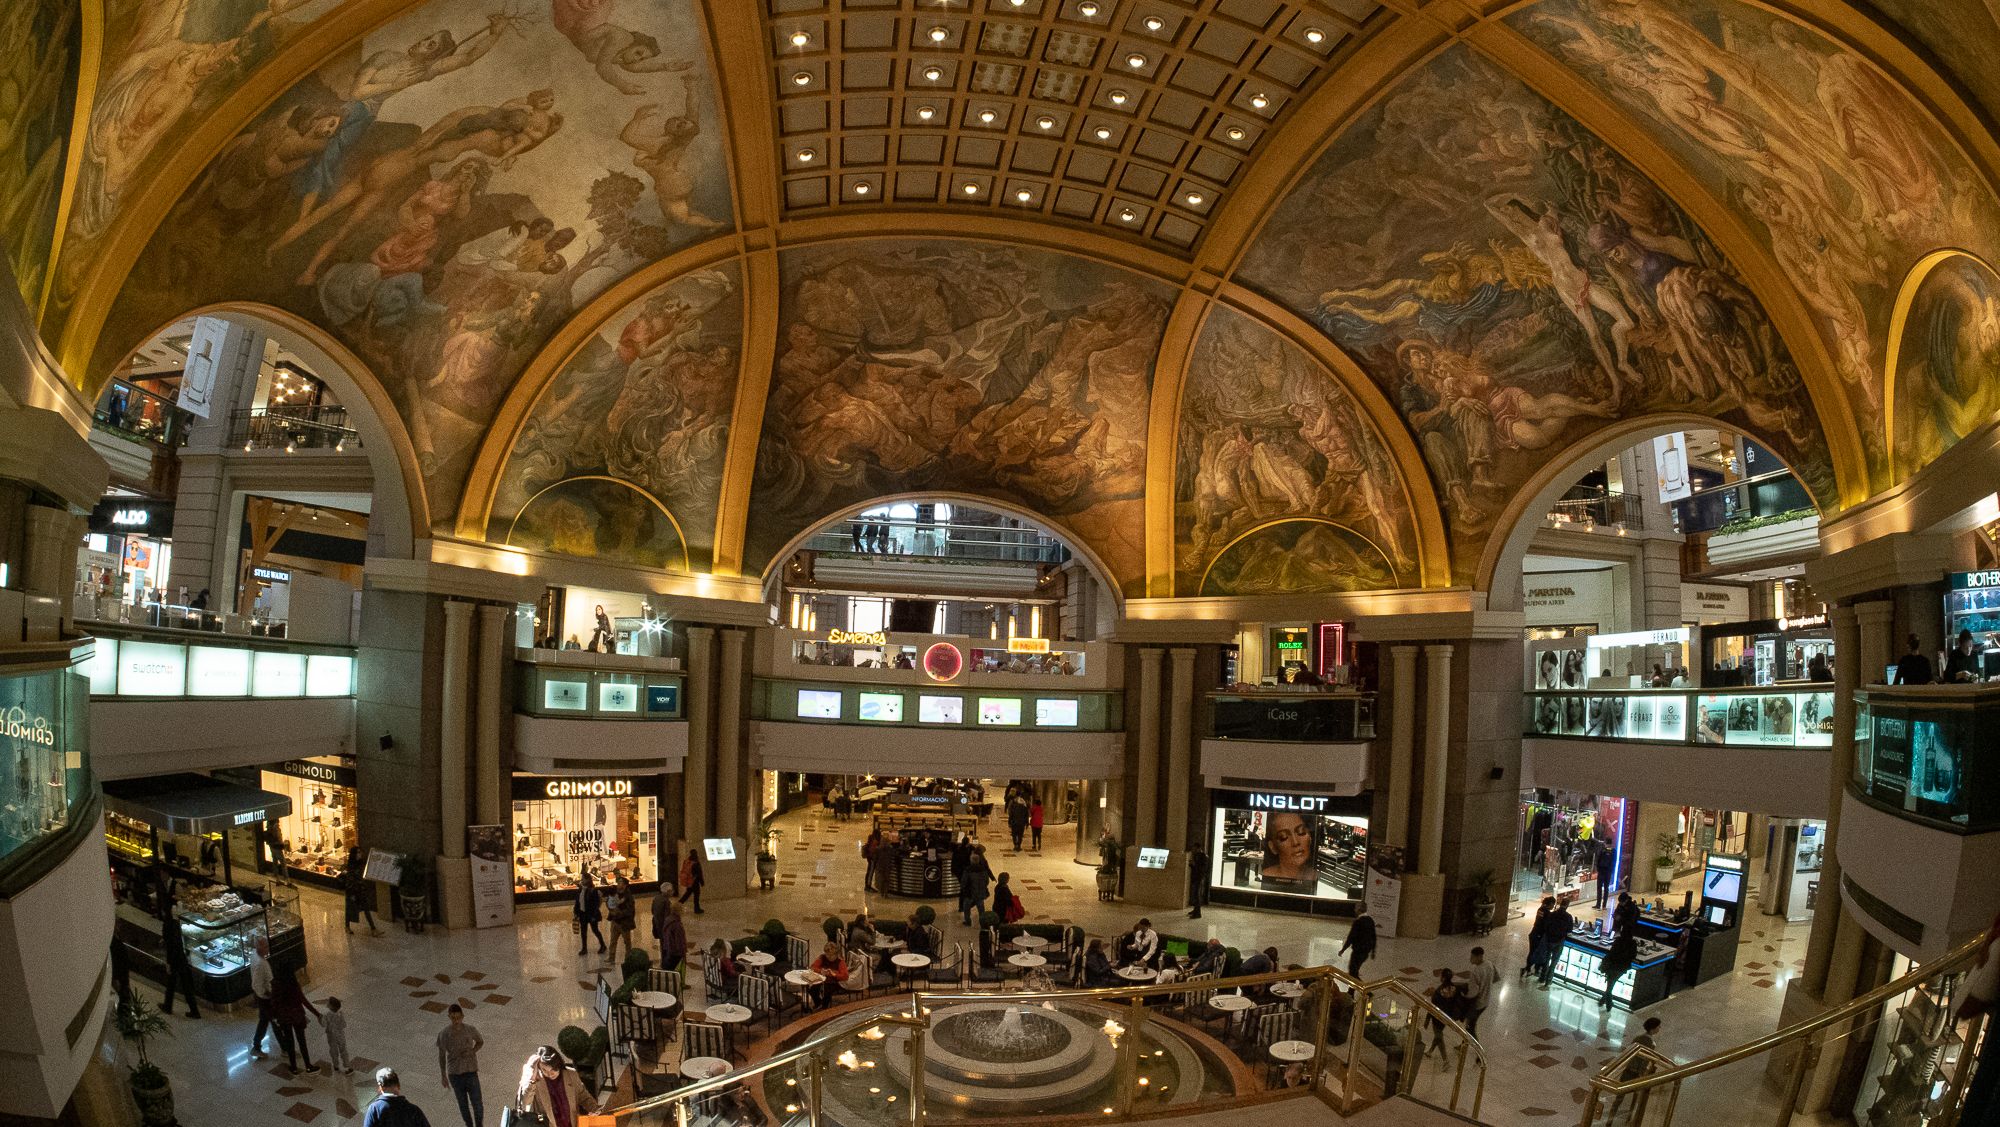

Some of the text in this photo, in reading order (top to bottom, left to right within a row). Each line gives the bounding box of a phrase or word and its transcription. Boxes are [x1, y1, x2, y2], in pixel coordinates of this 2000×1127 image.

[112, 509, 148, 525] ALDO
[254, 568, 289, 580] STYLE WATCH
[1528, 587, 1576, 597] MARTINA
[1814, 614, 1826, 625] hut
[1267, 707, 1298, 721] iCase
[284, 761, 336, 781] GRIMOLDI
[546, 780, 632, 797] GRIMOLDI
[1250, 793, 1329, 811] INGLOT
[234, 811, 253, 826] MADISON
[568, 828, 602, 844] GOOD
[568, 840, 603, 855] NEWS!
